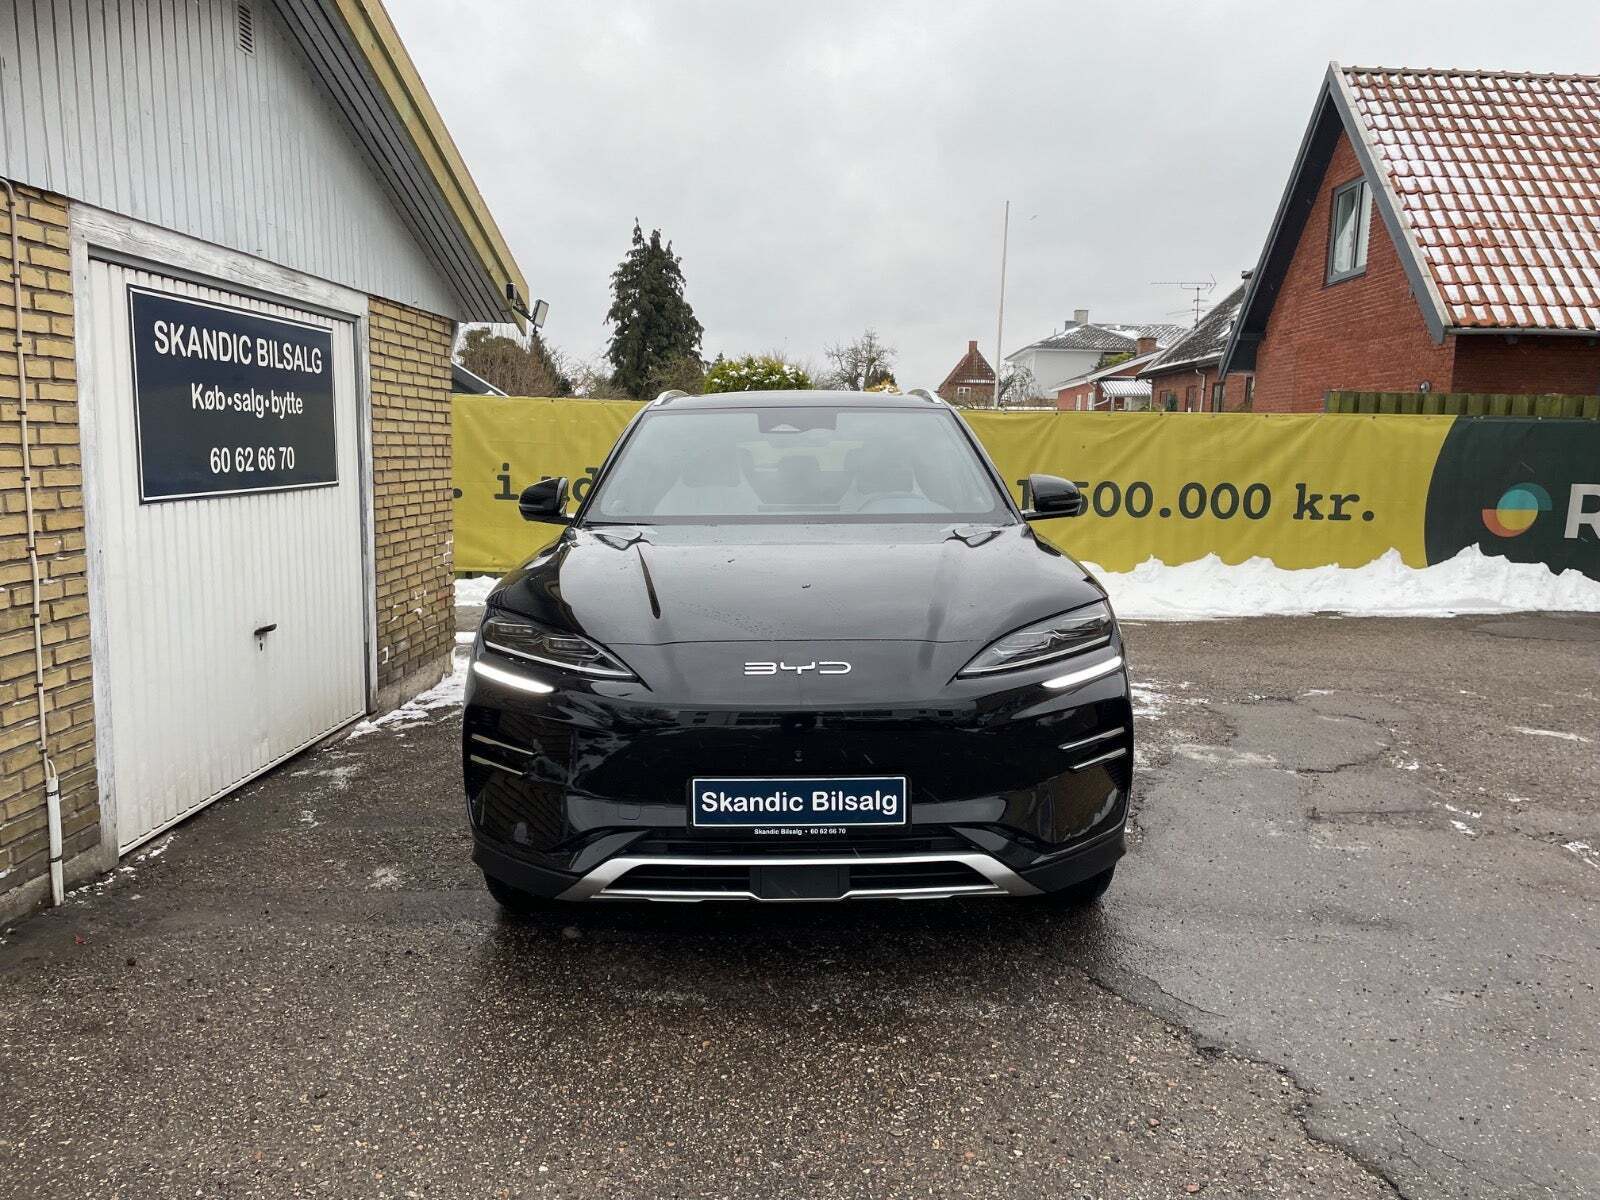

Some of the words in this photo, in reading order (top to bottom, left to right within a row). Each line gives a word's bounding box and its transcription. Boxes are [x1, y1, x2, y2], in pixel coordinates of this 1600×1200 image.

[154, 320, 252, 365] SKANDIC
[256, 338, 322, 374] BILSALG
[210, 447, 231, 474] 60
[235, 447, 255, 473] 62
[257, 446, 276, 471] 66
[279, 446, 295, 470] 70
[1292, 482, 1375, 522] kr.
[744, 661, 851, 675] BYD
[701, 791, 804, 812] Skandic
[811, 790, 897, 815] Bilsalg
[781, 828, 802, 836] Bilsalg
